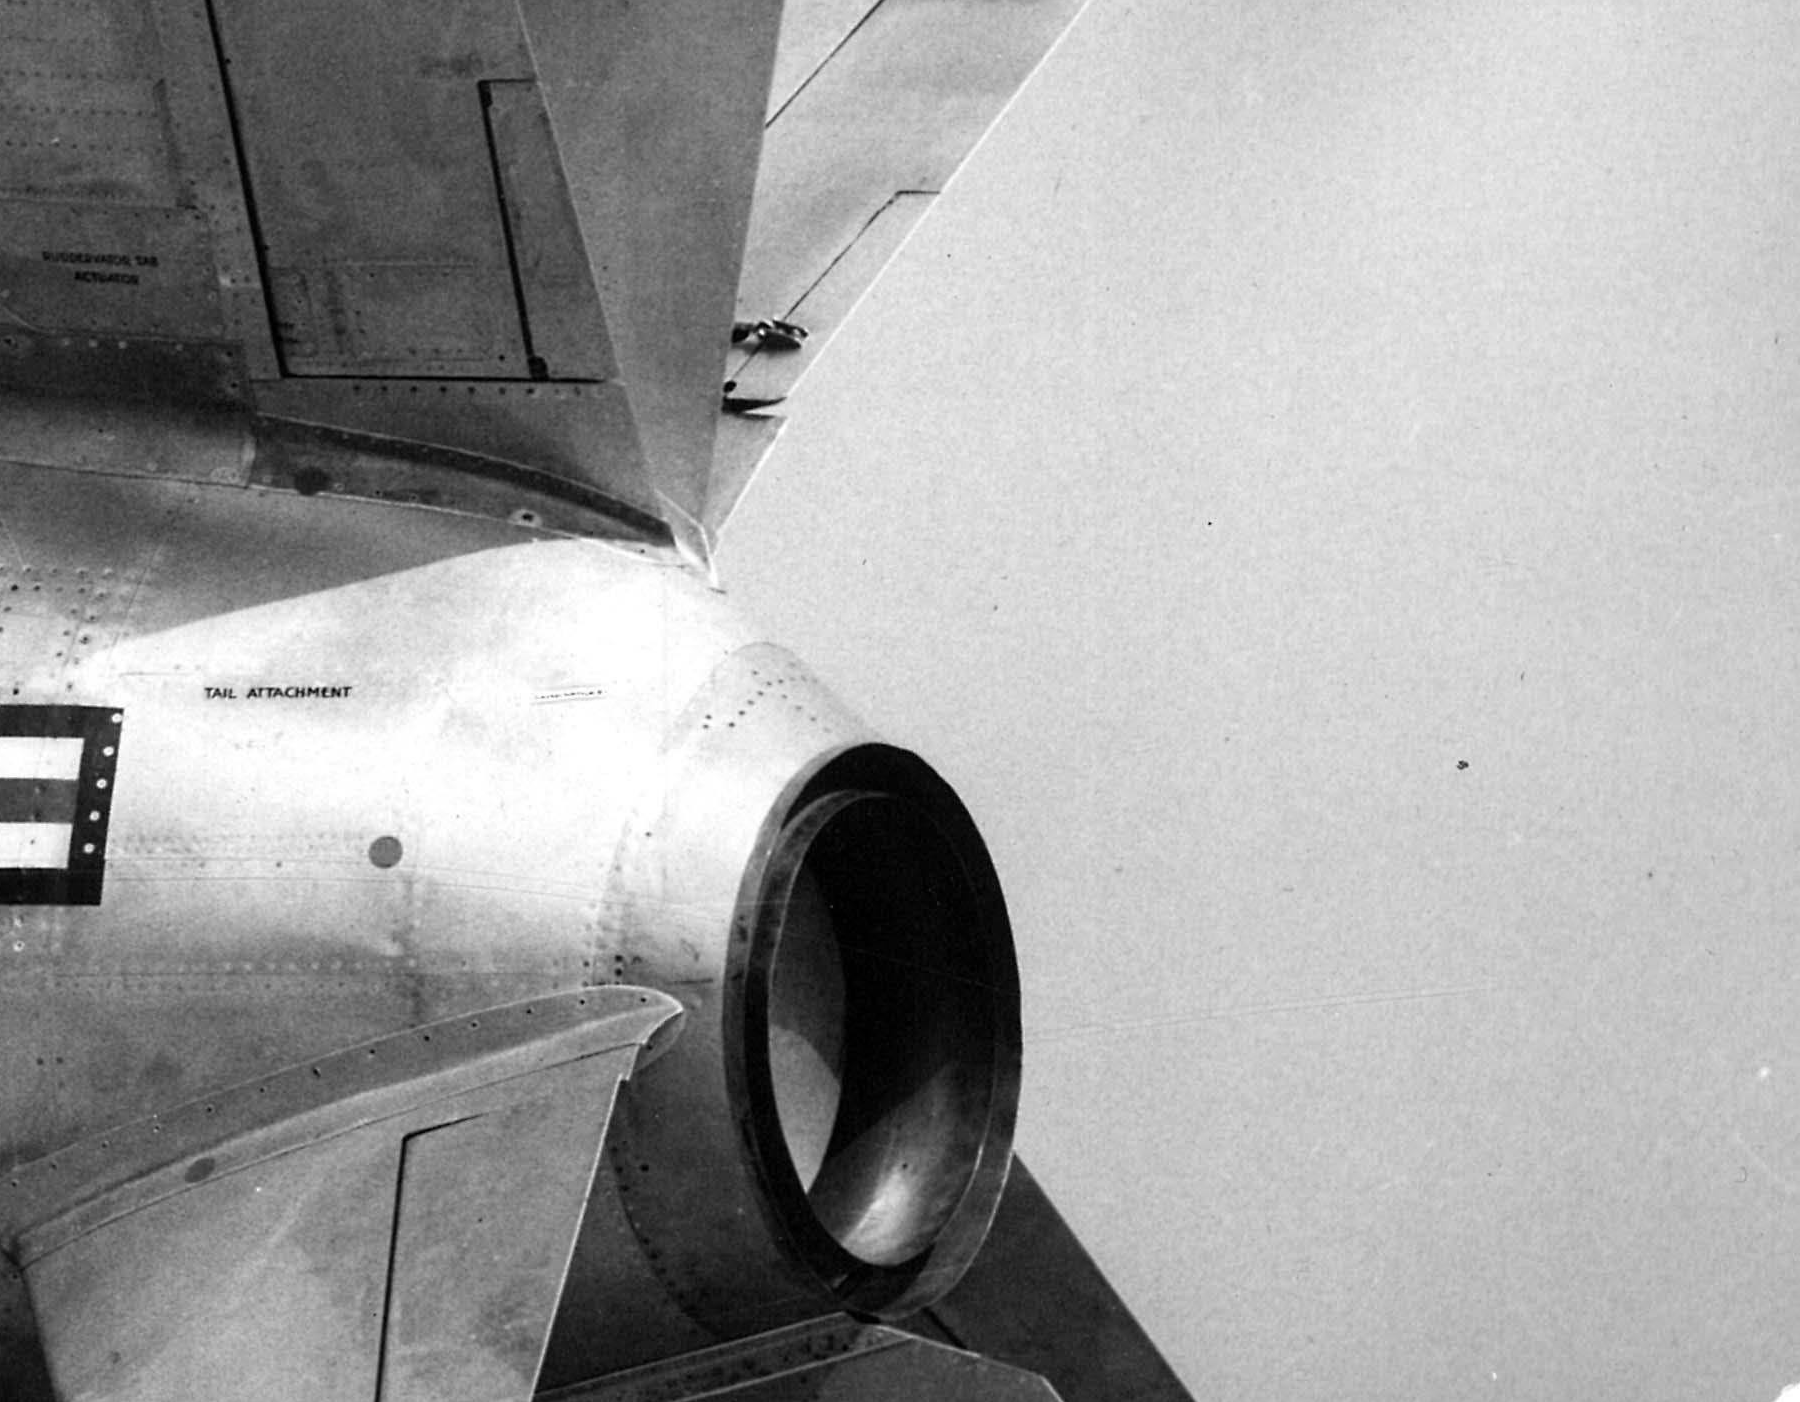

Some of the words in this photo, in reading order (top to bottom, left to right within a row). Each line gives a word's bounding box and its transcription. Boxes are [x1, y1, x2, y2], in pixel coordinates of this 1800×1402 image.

[74, 270, 140, 286] ACTUATOR
[204, 686, 237, 700] TAIL
[246, 685, 353, 700] ATTACHMENT
